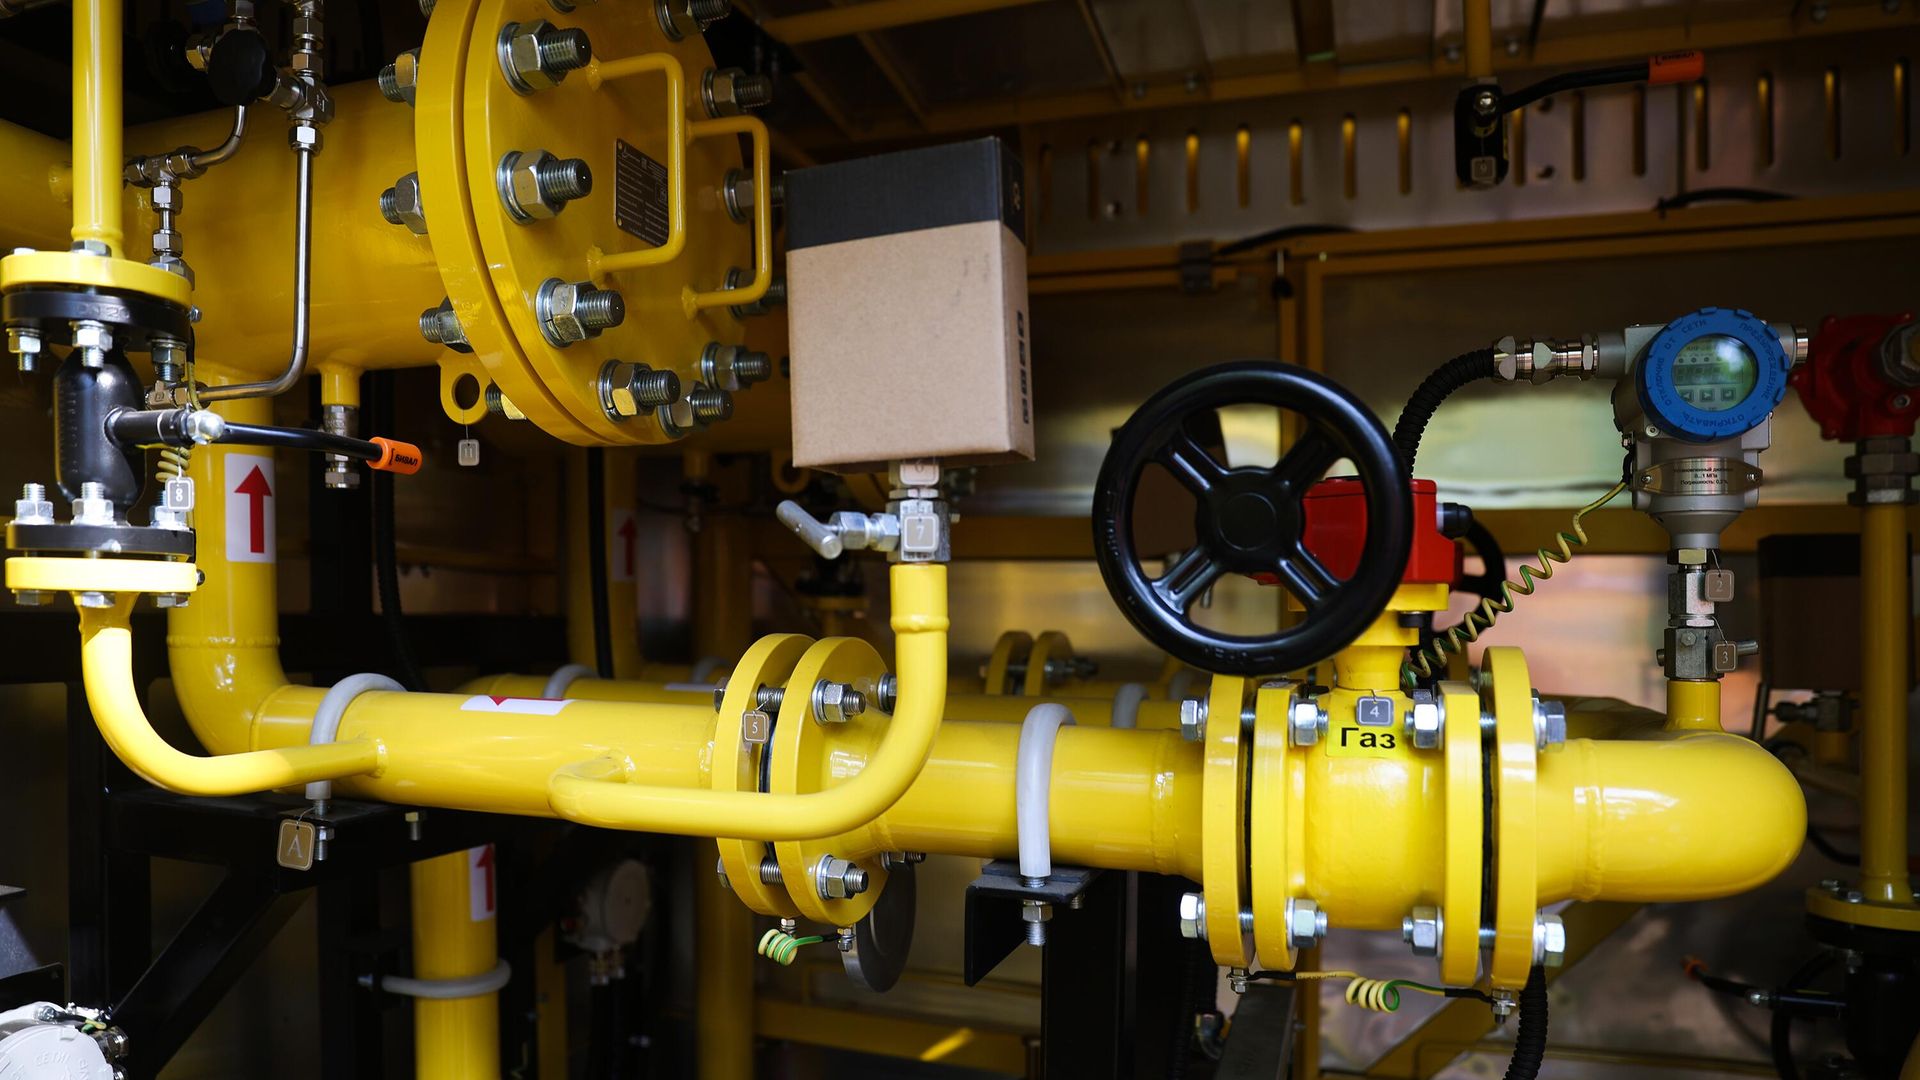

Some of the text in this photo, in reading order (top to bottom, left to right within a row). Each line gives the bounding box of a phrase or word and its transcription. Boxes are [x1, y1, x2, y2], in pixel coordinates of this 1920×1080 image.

[1682, 319, 1707, 334] СЕТИ
[464, 448, 473, 458] 11
[175, 488, 183, 502] 8
[916, 525, 925, 540] 7
[1715, 580, 1723, 592] 2
[1722, 651, 1729, 664] 3
[1369, 705, 1380, 718] 4
[752, 721, 758, 734] 5
[1341, 727, 1396, 749] Газ
